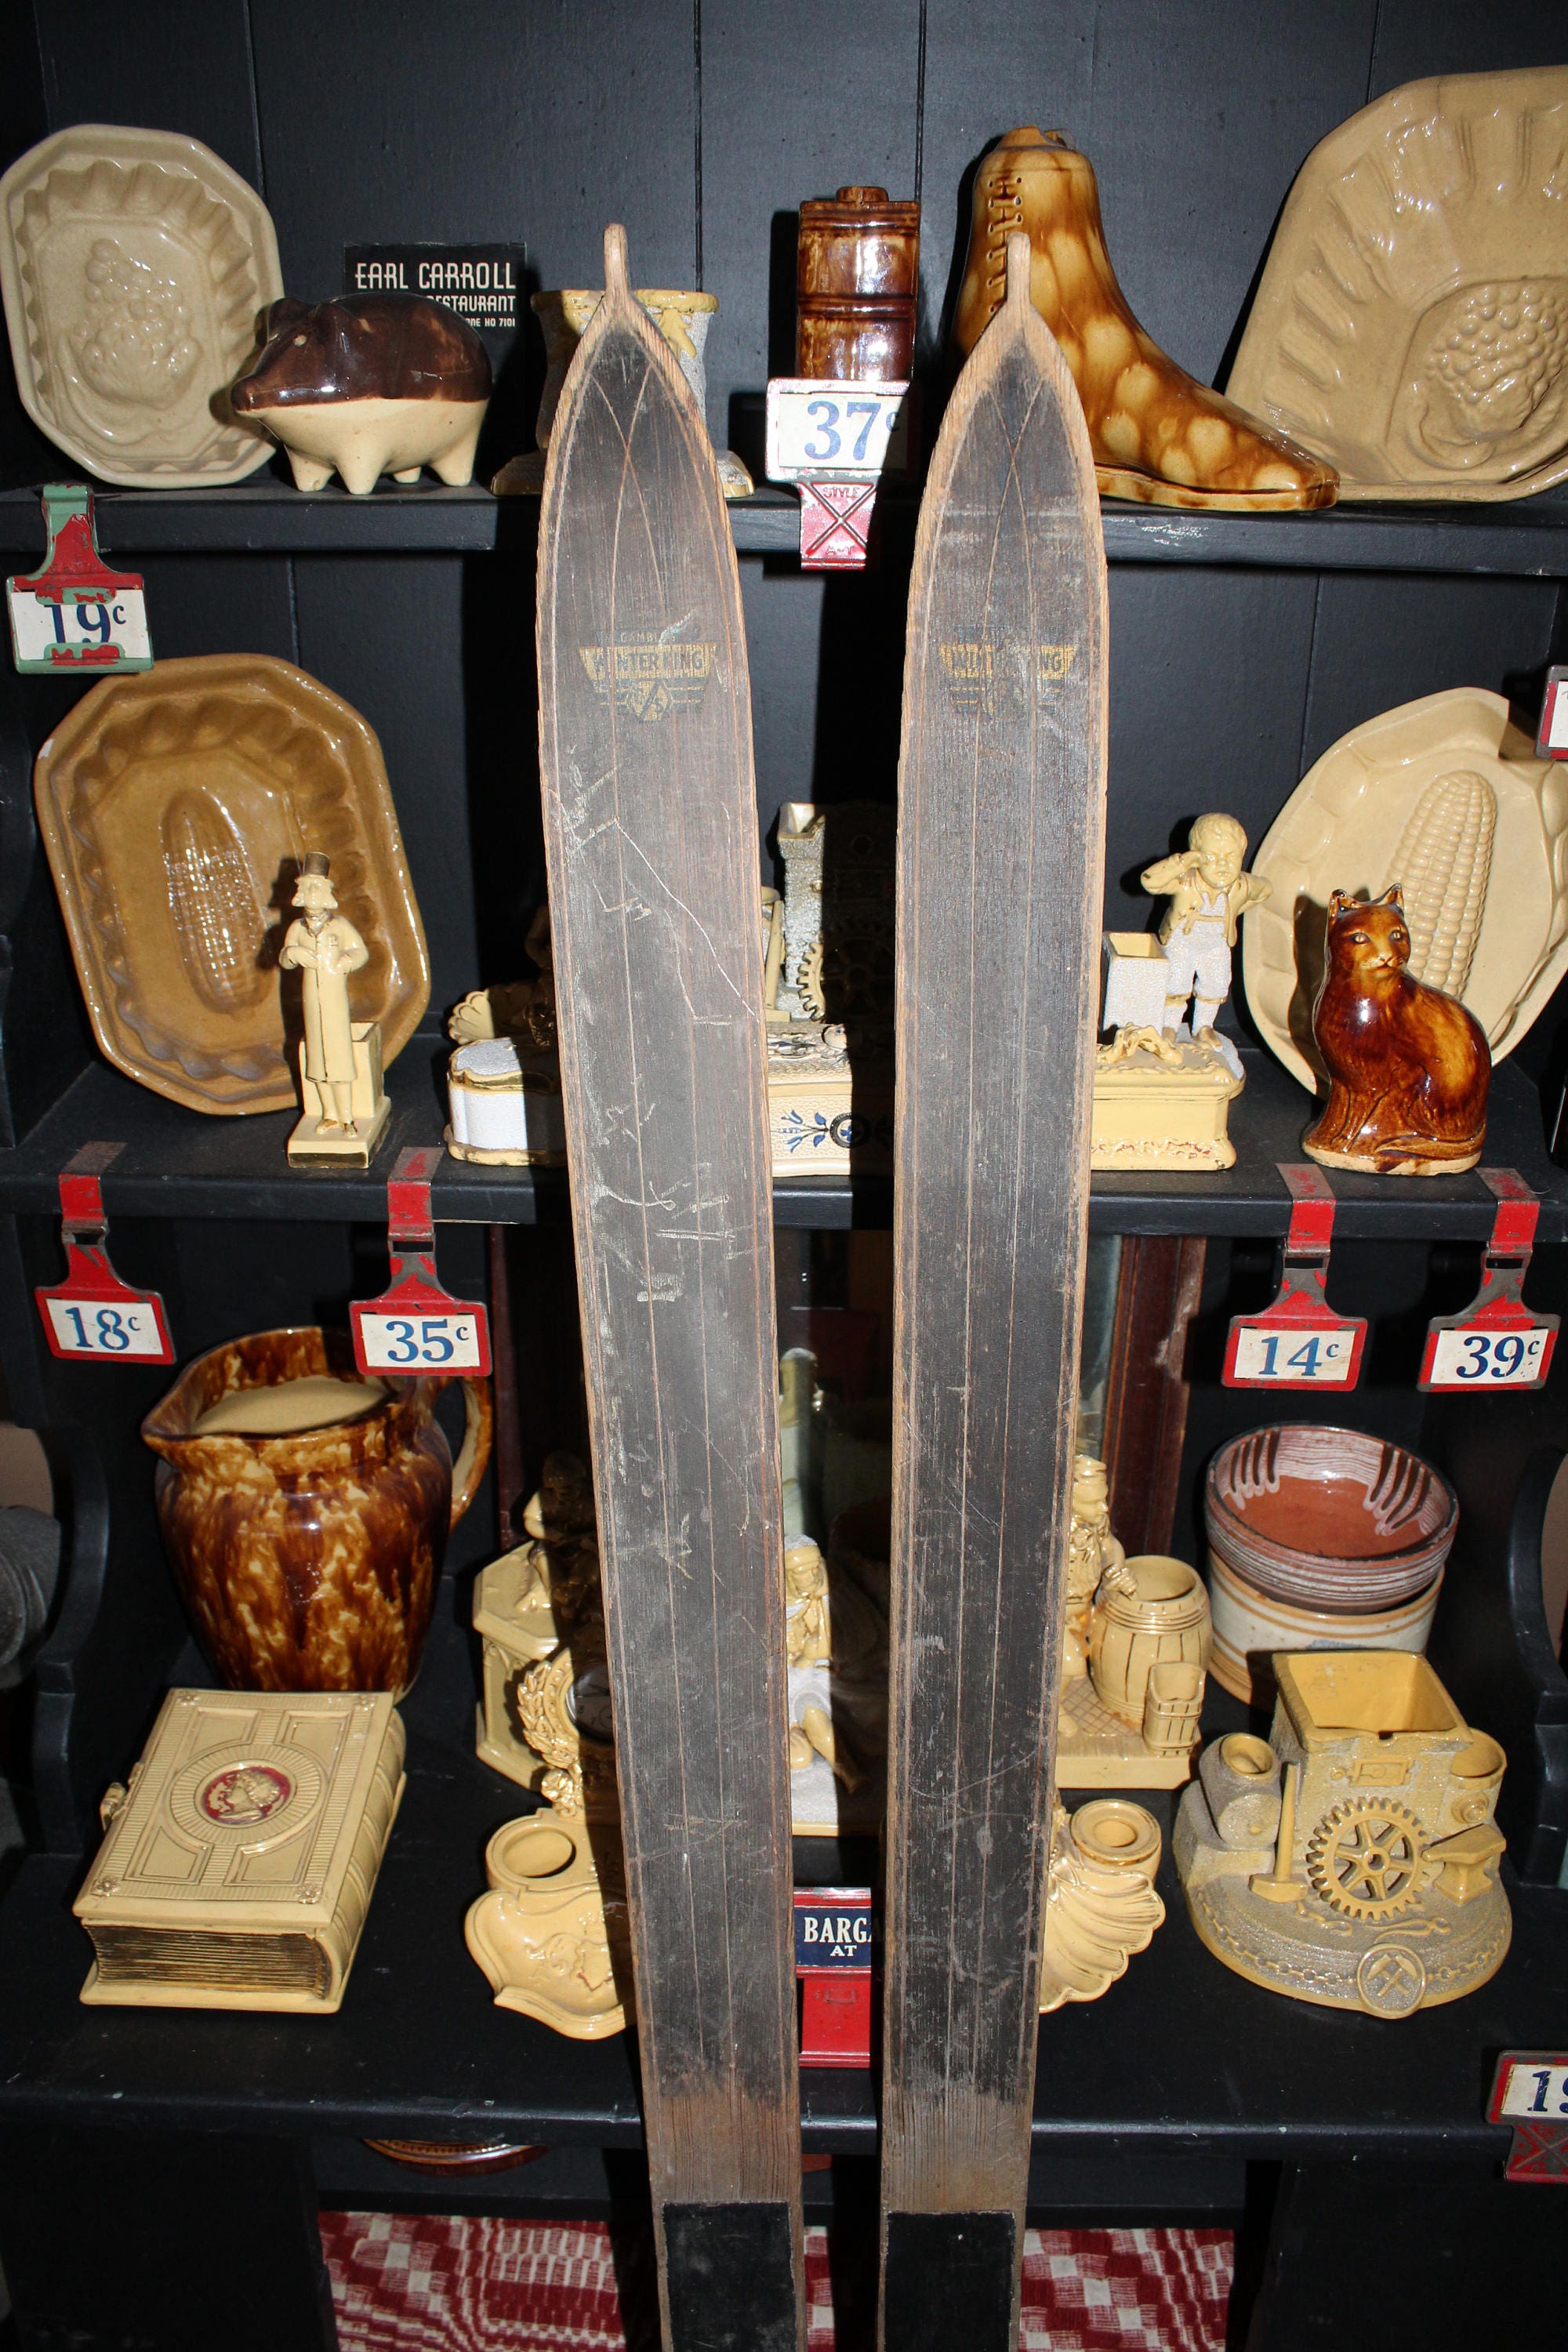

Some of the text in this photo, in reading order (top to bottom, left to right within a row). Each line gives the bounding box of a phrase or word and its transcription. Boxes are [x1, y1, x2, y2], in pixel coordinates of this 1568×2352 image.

[355, 263, 516, 289] EARL CARROLL
[426, 295, 516, 311] STAURANT
[499, 318, 515, 327] 7101
[823, 486, 860, 498] STYLE
[592, 652, 659, 673] WNTER
[829, 1945, 857, 1957] AT
